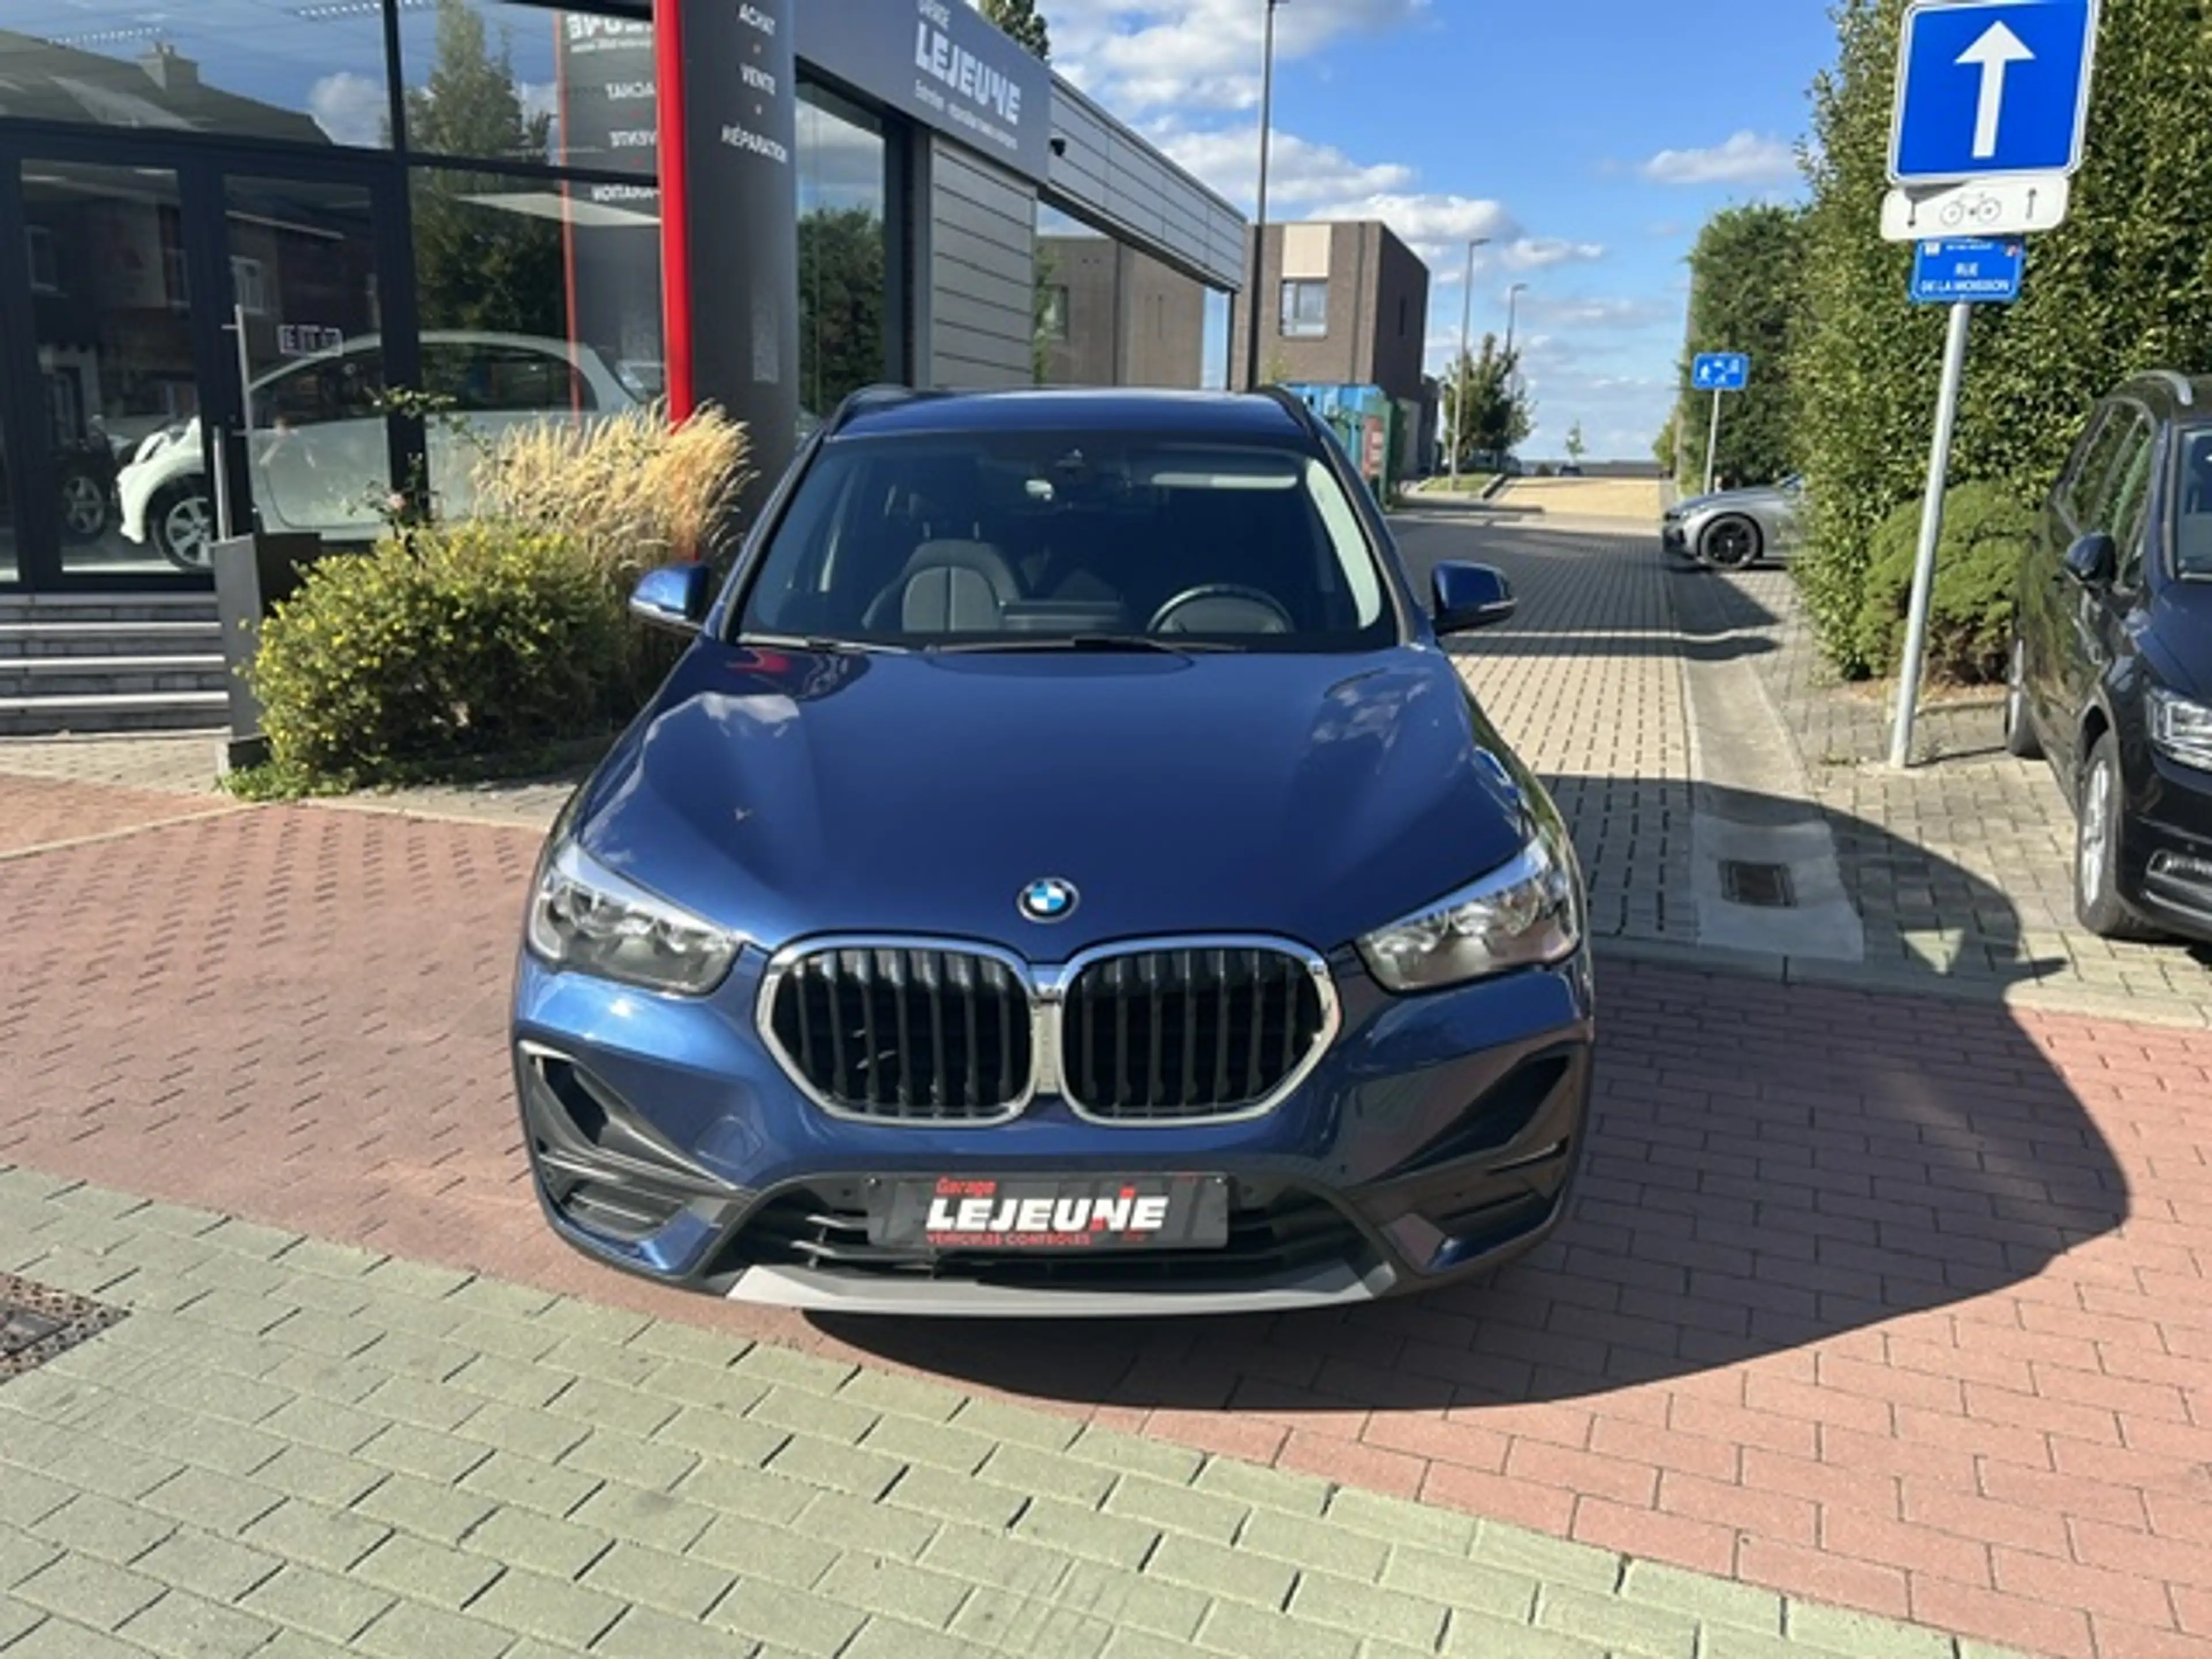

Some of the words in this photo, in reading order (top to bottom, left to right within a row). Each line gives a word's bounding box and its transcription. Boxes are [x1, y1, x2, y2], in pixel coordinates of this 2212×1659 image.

[738, 3, 775, 36] ACHAT
[740, 63, 775, 95] VENTE
[925, 1184, 1169, 1232] LEJEUNE
